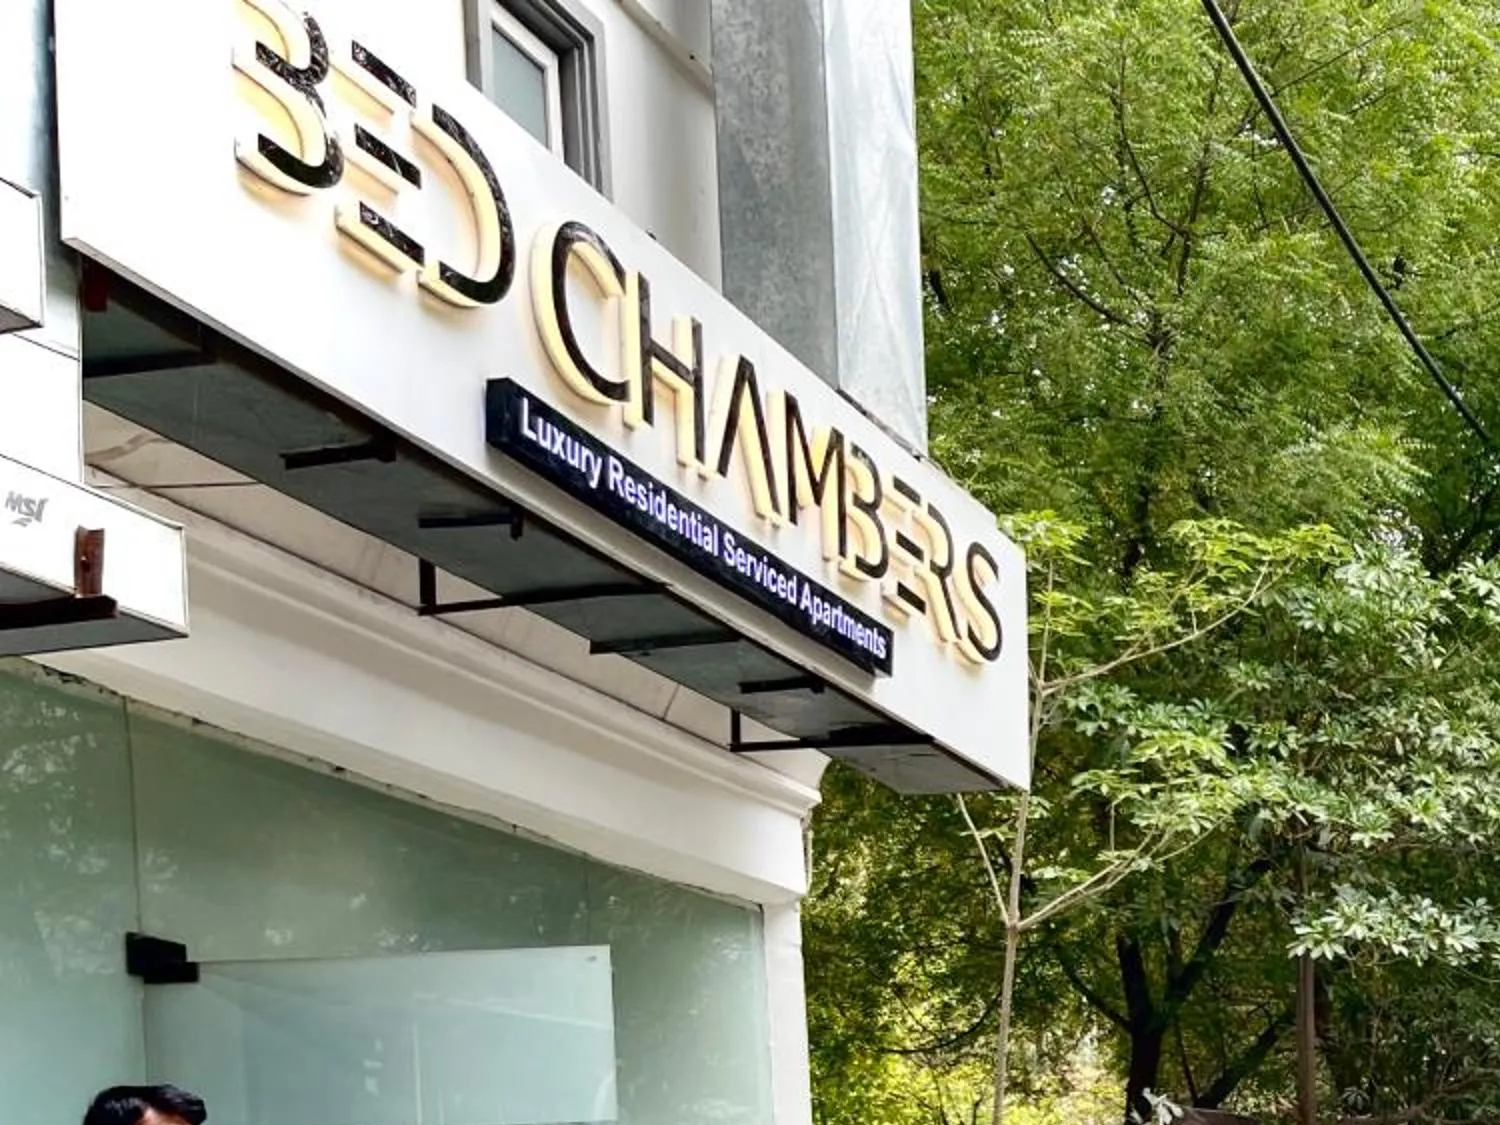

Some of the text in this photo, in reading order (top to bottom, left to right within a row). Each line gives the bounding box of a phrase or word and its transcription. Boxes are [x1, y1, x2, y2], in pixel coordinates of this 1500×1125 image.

[232, 0, 1003, 666] BED CHAMBERS
[520, 396, 888, 659] Luxury Residential Serviced Apartments
